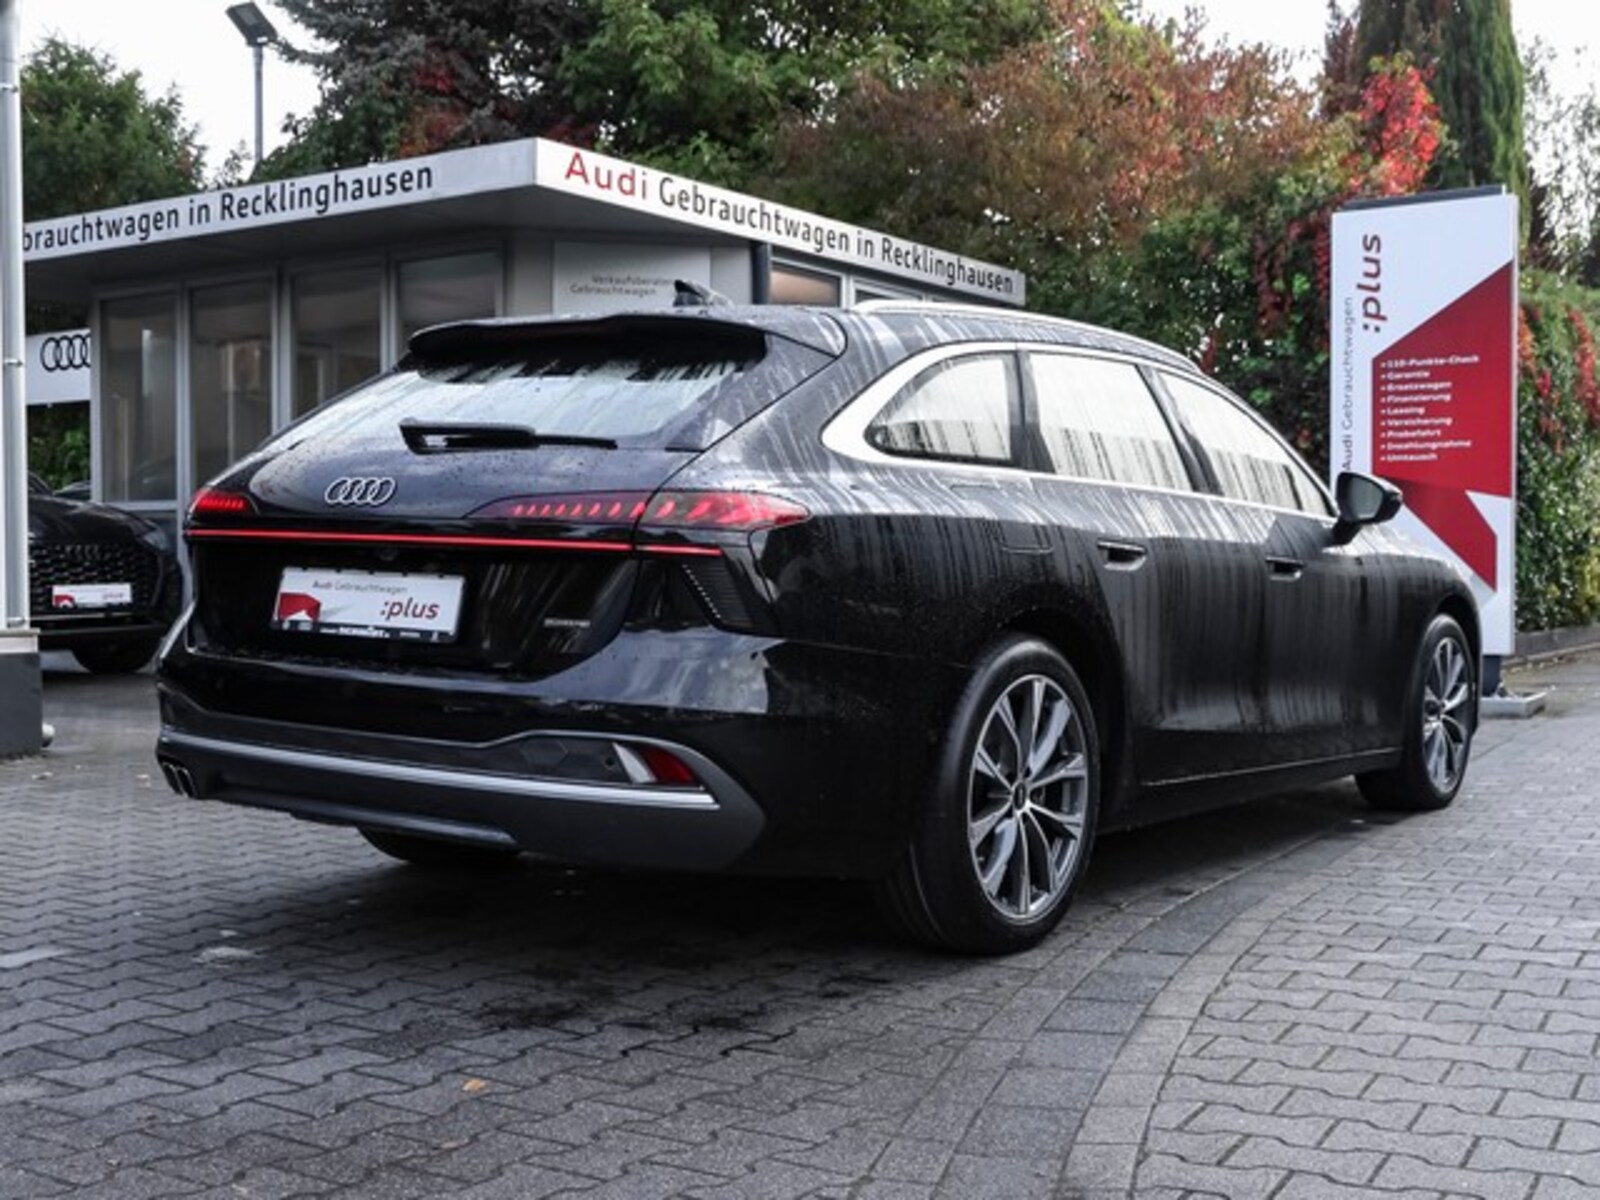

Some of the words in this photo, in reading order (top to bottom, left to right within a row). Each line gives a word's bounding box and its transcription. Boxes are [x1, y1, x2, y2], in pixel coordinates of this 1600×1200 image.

[188, 200, 211, 226] in
[220, 165, 433, 222] Recklinghausen
[564, 151, 647, 200] Audi
[659, 177, 849, 255] Gebrauchtwagen
[856, 230, 875, 259] in
[881, 237, 1014, 294] Recklinghausen
[1356, 233, 1388, 333] :plus
[1342, 297, 1356, 431] Gebrauchtwagen
[1342, 434, 1354, 470] Audi
[380, 596, 440, 621] :plus
